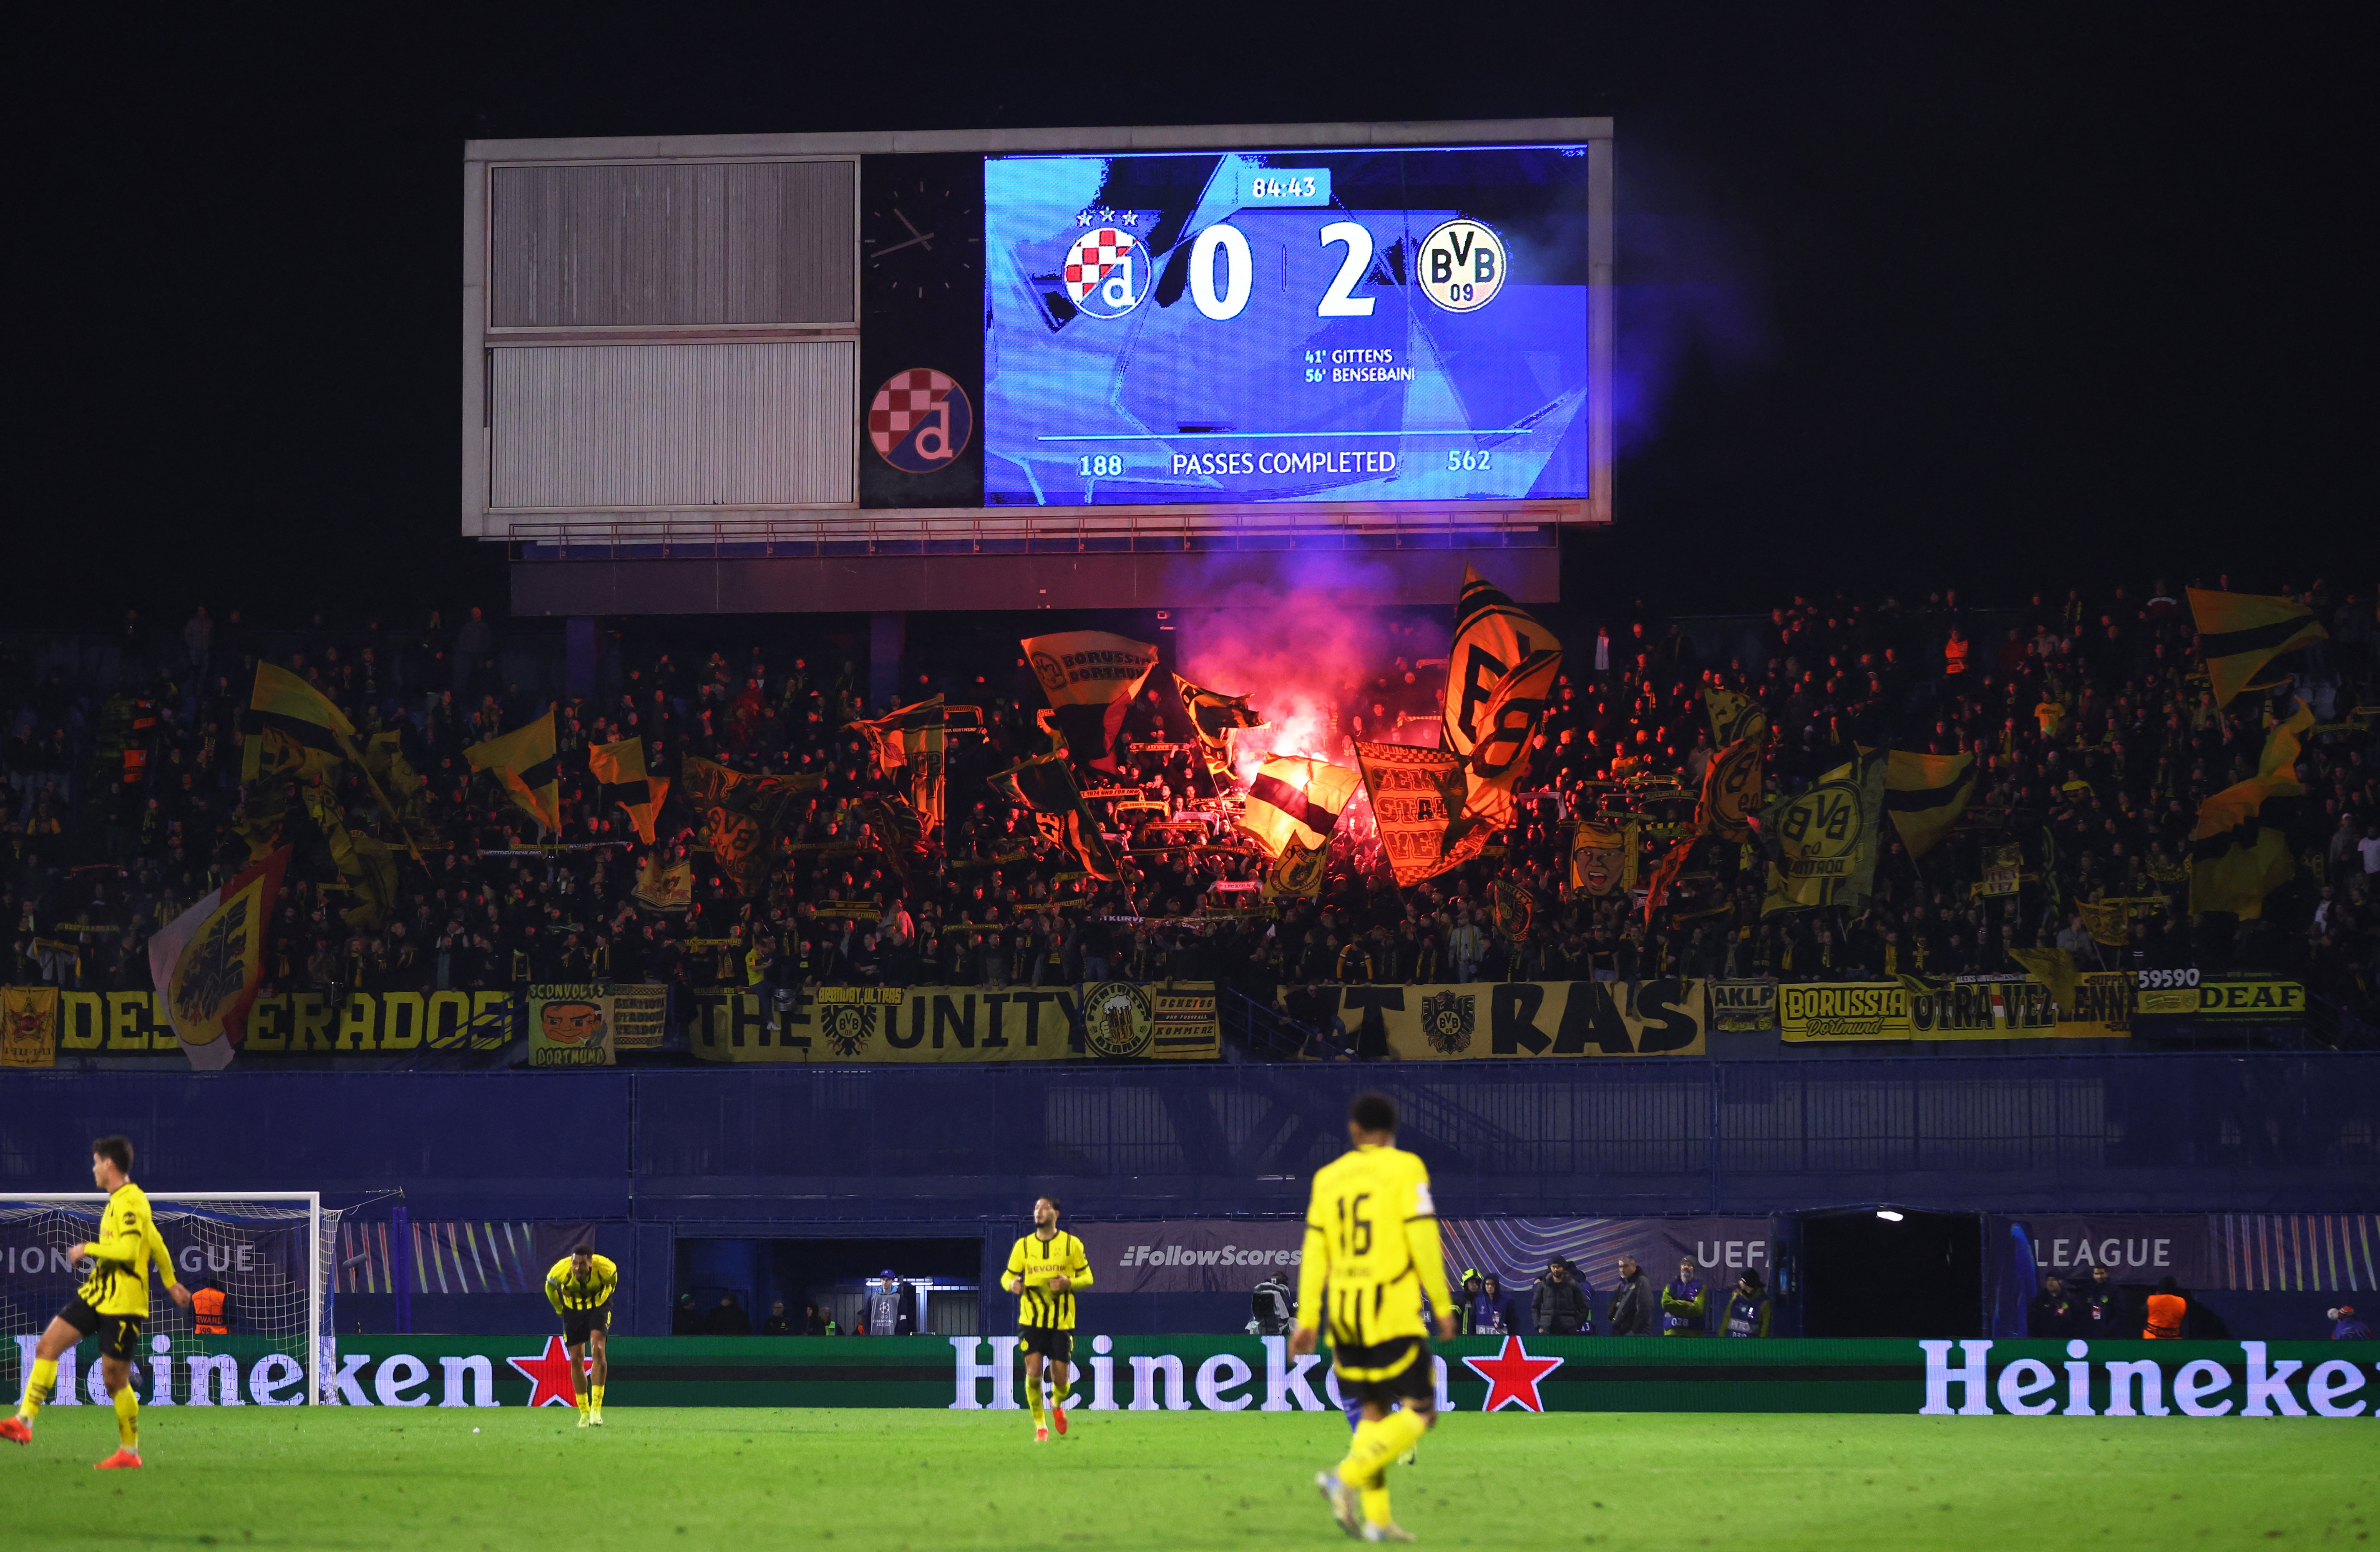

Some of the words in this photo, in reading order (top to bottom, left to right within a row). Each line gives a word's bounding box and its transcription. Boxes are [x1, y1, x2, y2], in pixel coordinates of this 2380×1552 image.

[1252, 177, 1316, 199] 84:43
[1431, 231, 1496, 285] BVB
[1189, 224, 1253, 320] 0
[1317, 222, 1376, 317] 2
[1449, 284, 1474, 302] 09
[1332, 349, 1393, 364] GITTENS
[1333, 367, 1414, 382] BENSEBAINI
[1079, 456, 1122, 477] 188
[1172, 453, 1253, 476] PASSES
[1258, 451, 1396, 474] COMPLETED
[1447, 451, 1492, 471] 562
[1069, 666, 1145, 684] DORTMUN
[2138, 968, 2200, 988] 59590
[529, 984, 604, 999] SCONVOLTS
[1715, 987, 1775, 1006] AKLP
[2199, 986, 2302, 1008] DEAF
[1789, 988, 1907, 1017] BORUSSIA
[61, 990, 514, 1051] DESERADOS
[696, 994, 812, 1048] THE
[885, 991, 1084, 1050] UNITY
[839, 1013, 859, 1030] BVB
[1155, 1026, 1214, 1036] KOMMERZ
[1439, 1013, 1459, 1028] BVB
[1806, 1016, 1882, 1036] Dortmund
[537, 1047, 605, 1065] DORTMUND
[1337, 1193, 1372, 1255] 16
[0, 1247, 96, 1273] IONS
[1133, 1245, 1301, 1266] FollowScores
[1698, 1241, 1770, 1269] UEF
[2035, 1238, 2171, 1267] LEAGUE
[196, 1315, 224, 1324] EWARD
[948, 1335, 1455, 1411] Heinek
[1919, 1339, 2380, 1417] Heineke
